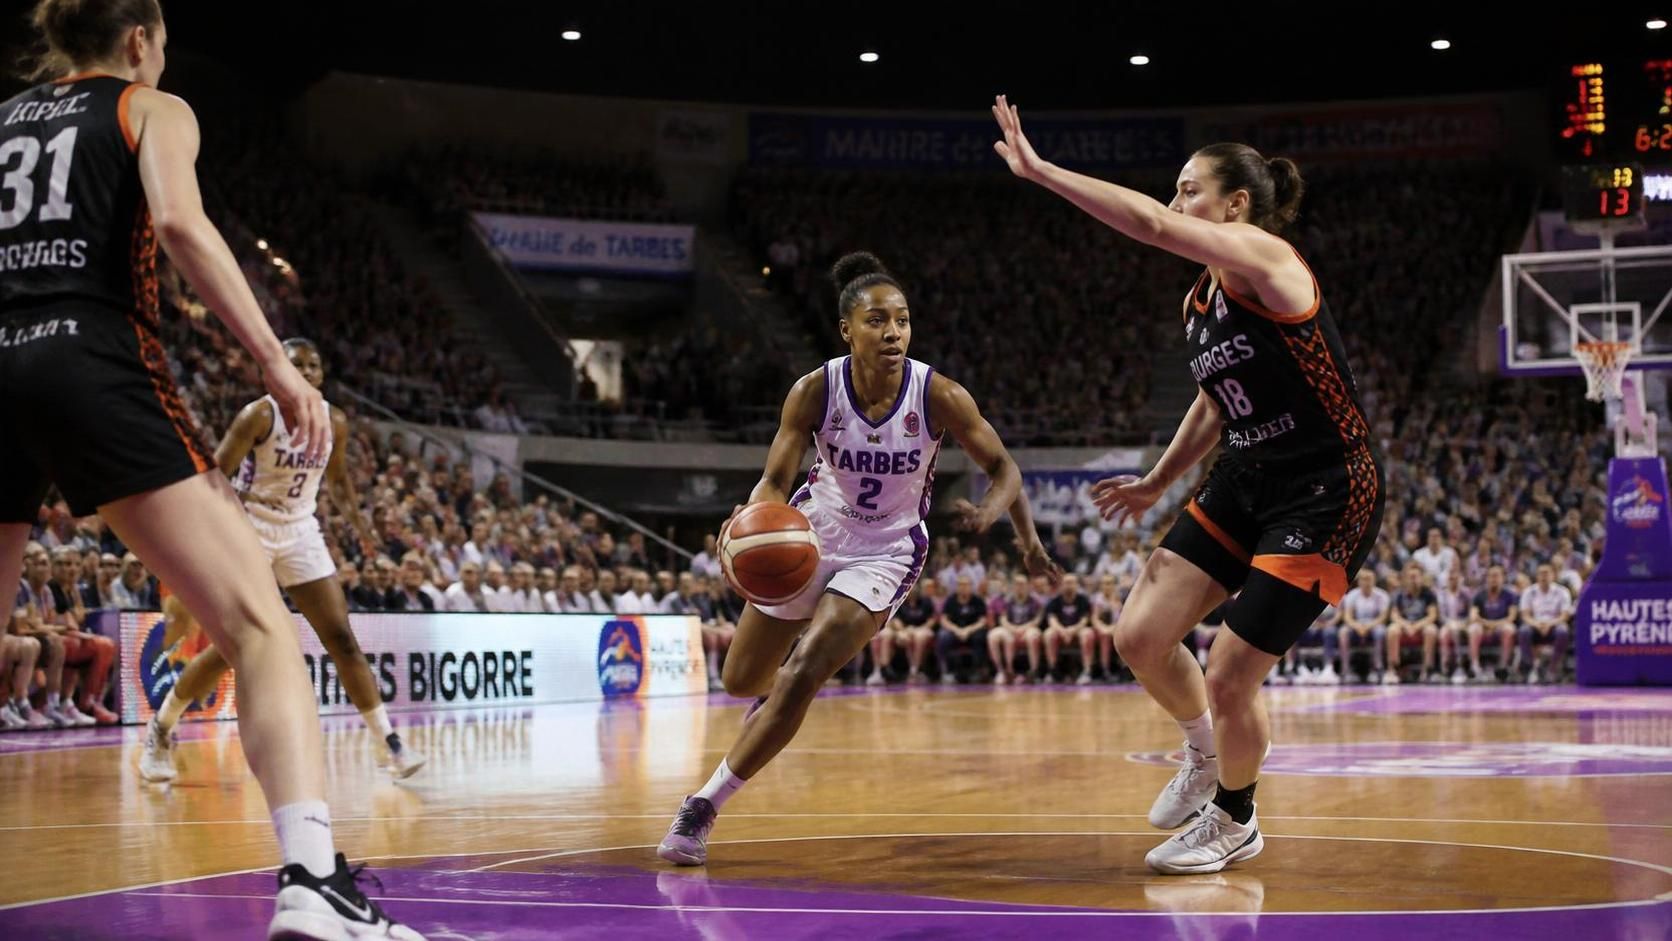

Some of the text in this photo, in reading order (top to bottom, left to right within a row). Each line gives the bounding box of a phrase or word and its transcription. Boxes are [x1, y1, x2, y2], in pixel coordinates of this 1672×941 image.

[0, 126, 78, 230] 31
[1600, 188, 1630, 216] 13
[1214, 378, 1253, 420] 18
[826, 442, 921, 475] TARBES
[856, 477, 882, 510] 2
[409, 650, 534, 702] BIGORRE
